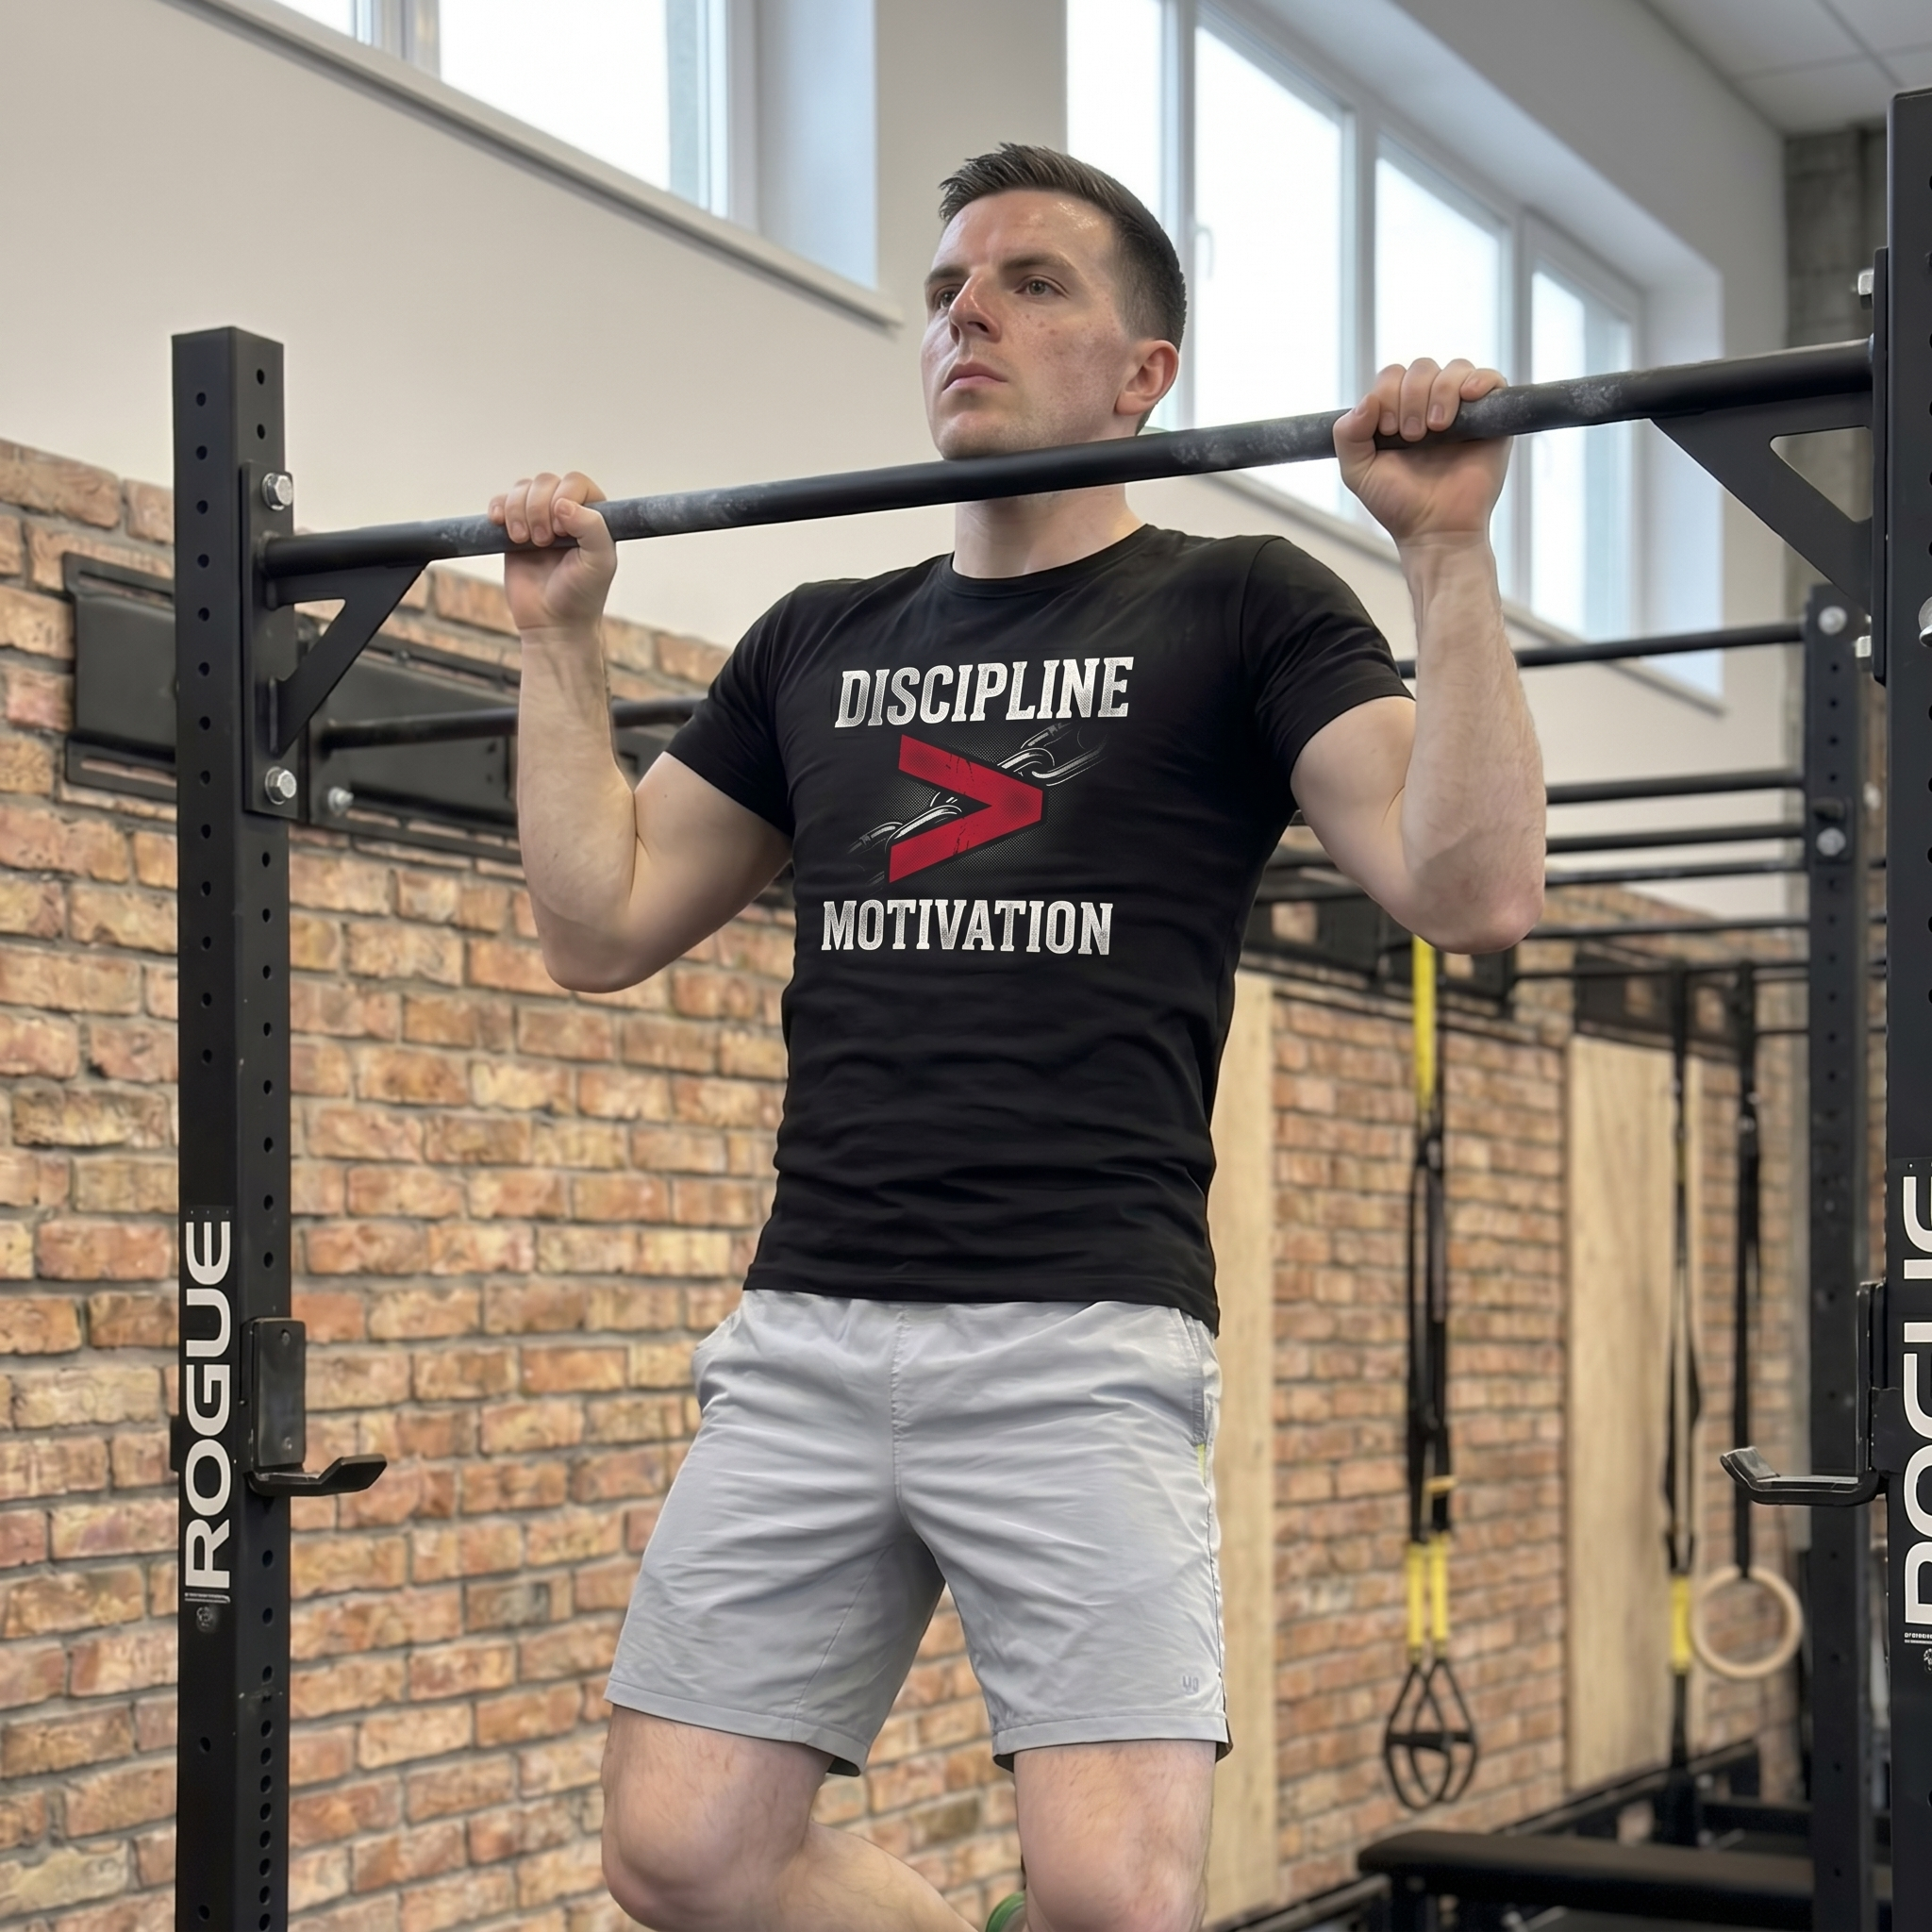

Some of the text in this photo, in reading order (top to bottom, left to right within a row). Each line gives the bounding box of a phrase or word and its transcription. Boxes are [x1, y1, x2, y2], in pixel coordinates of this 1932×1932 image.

[834, 656, 1135, 728] DISCIPLINE
[821, 898, 1114, 956] MOTIVATION
[185, 1221, 231, 1590] ROGUE
